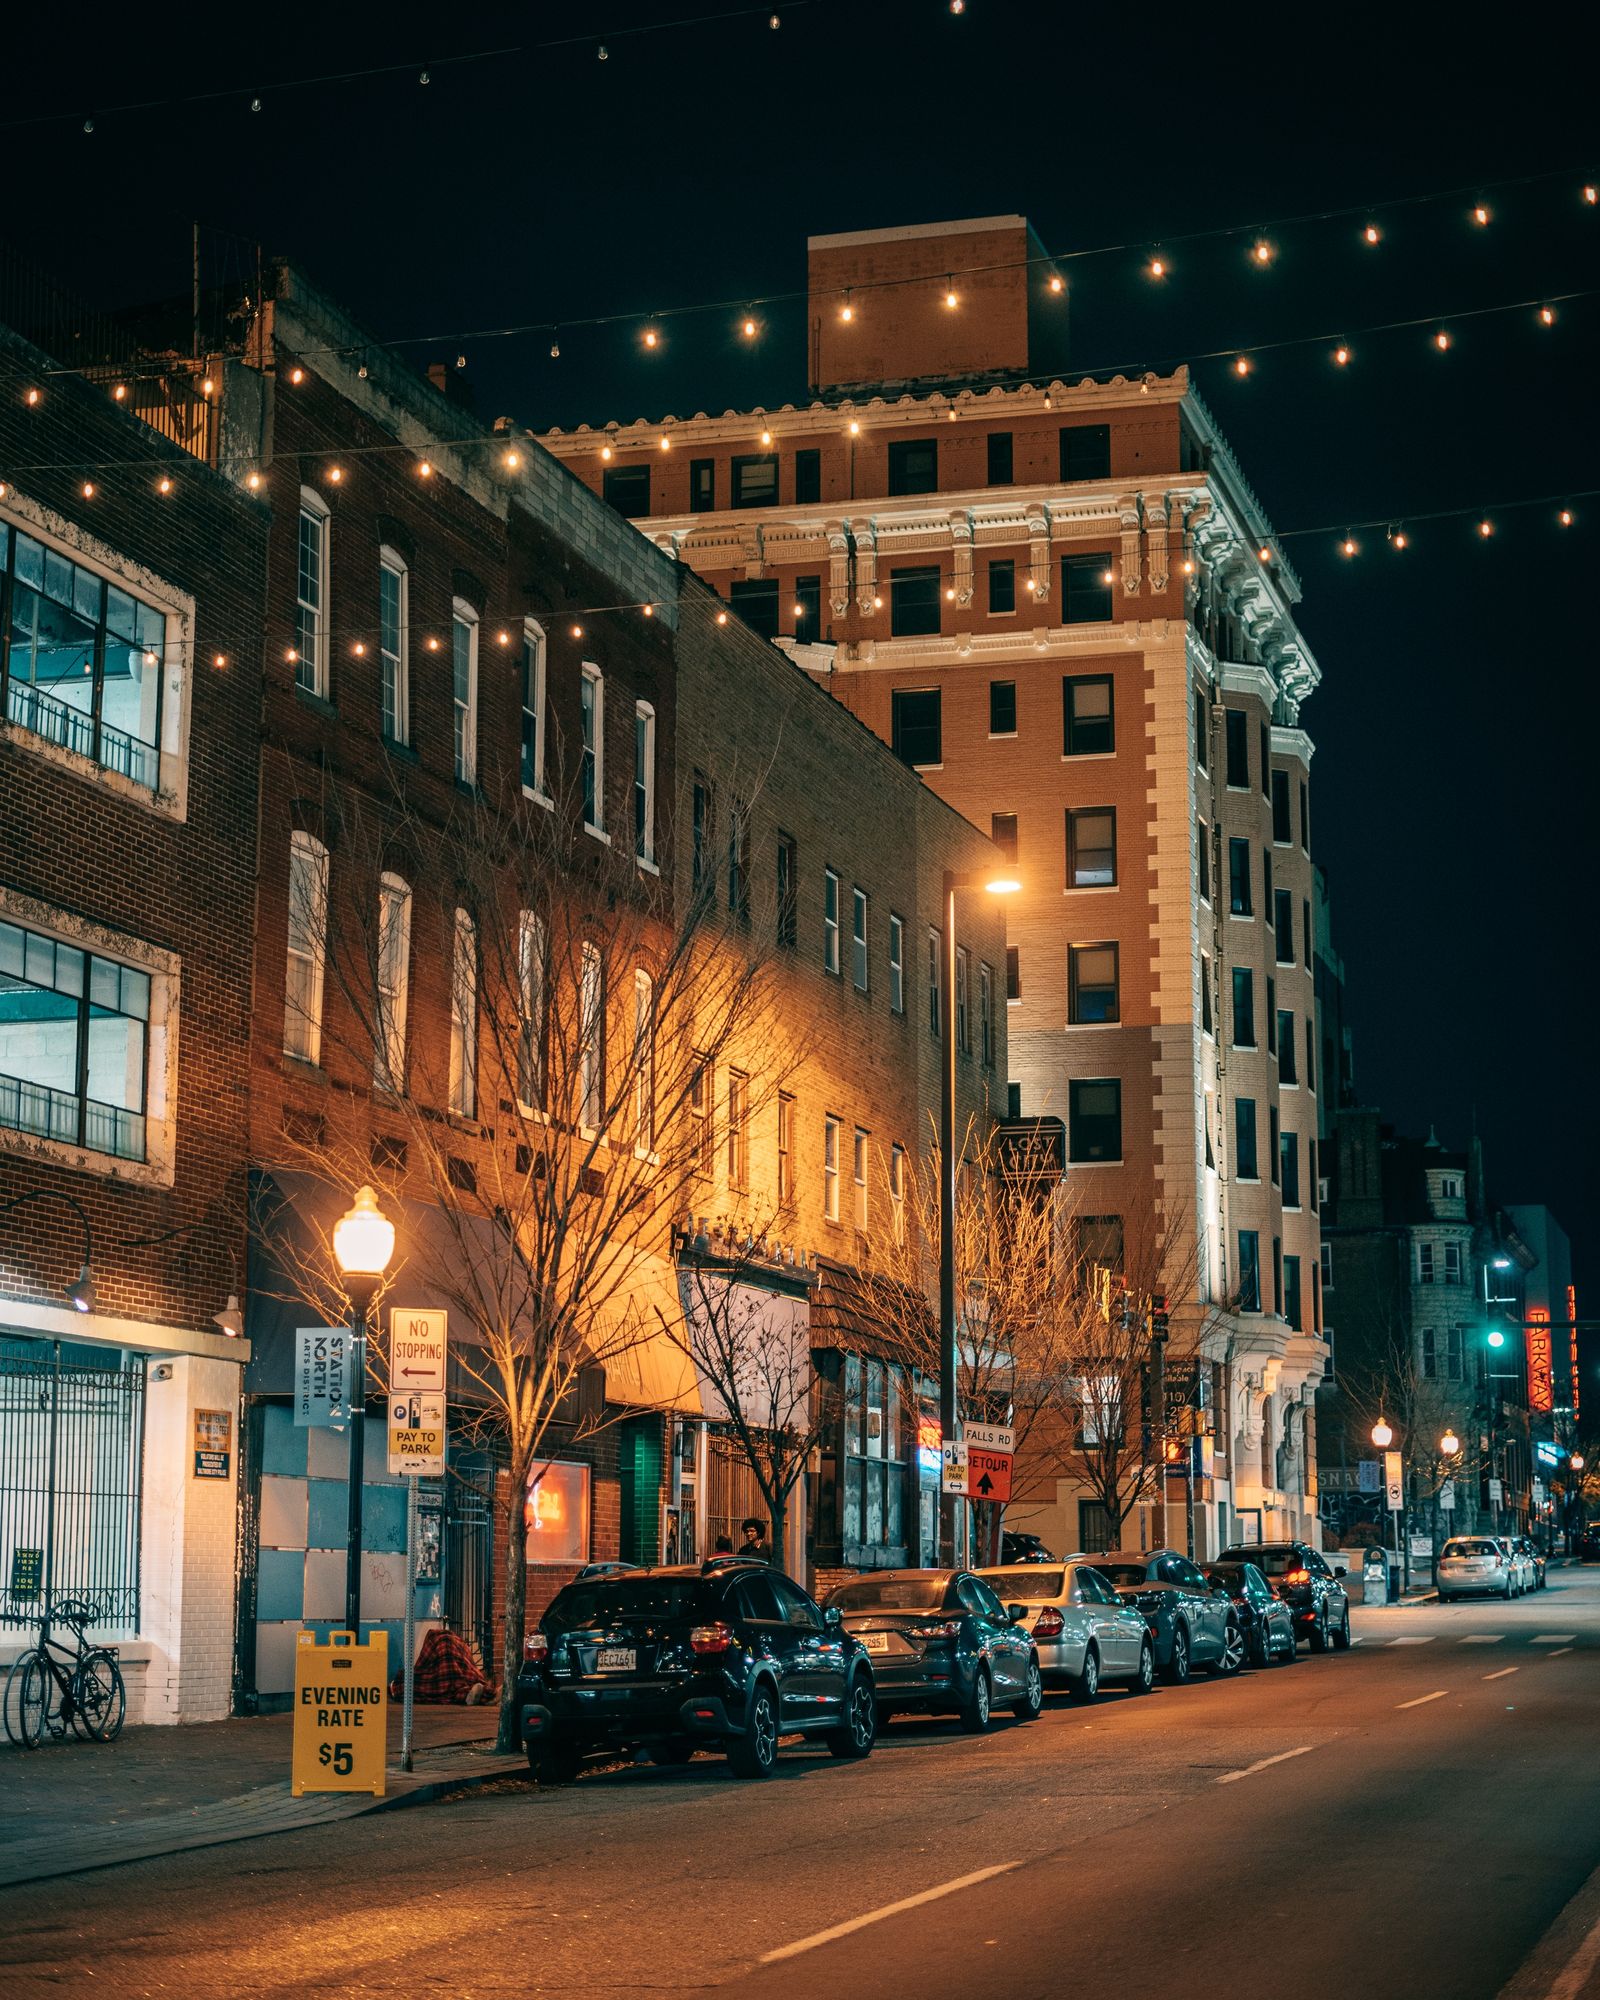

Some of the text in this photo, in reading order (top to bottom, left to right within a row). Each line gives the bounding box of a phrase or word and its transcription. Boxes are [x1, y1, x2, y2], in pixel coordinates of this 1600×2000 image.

[409, 1320, 429, 1337] NO
[396, 1342, 442, 1359] STOPPING
[314, 1337, 327, 1399] NORTH
[1530, 1312, 1549, 1409] PARKWAY
[302, 1338, 311, 1416] ARTS DISTRICT
[329, 1337, 343, 1417] STATION
[397, 1432, 436, 1443] PAY TO
[966, 1429, 1011, 1445] FALLS RD
[401, 1444, 431, 1454] PARK
[301, 1687, 381, 1705] EVENING
[317, 1709, 364, 1727] RATE
[319, 1742, 353, 1775] $5
